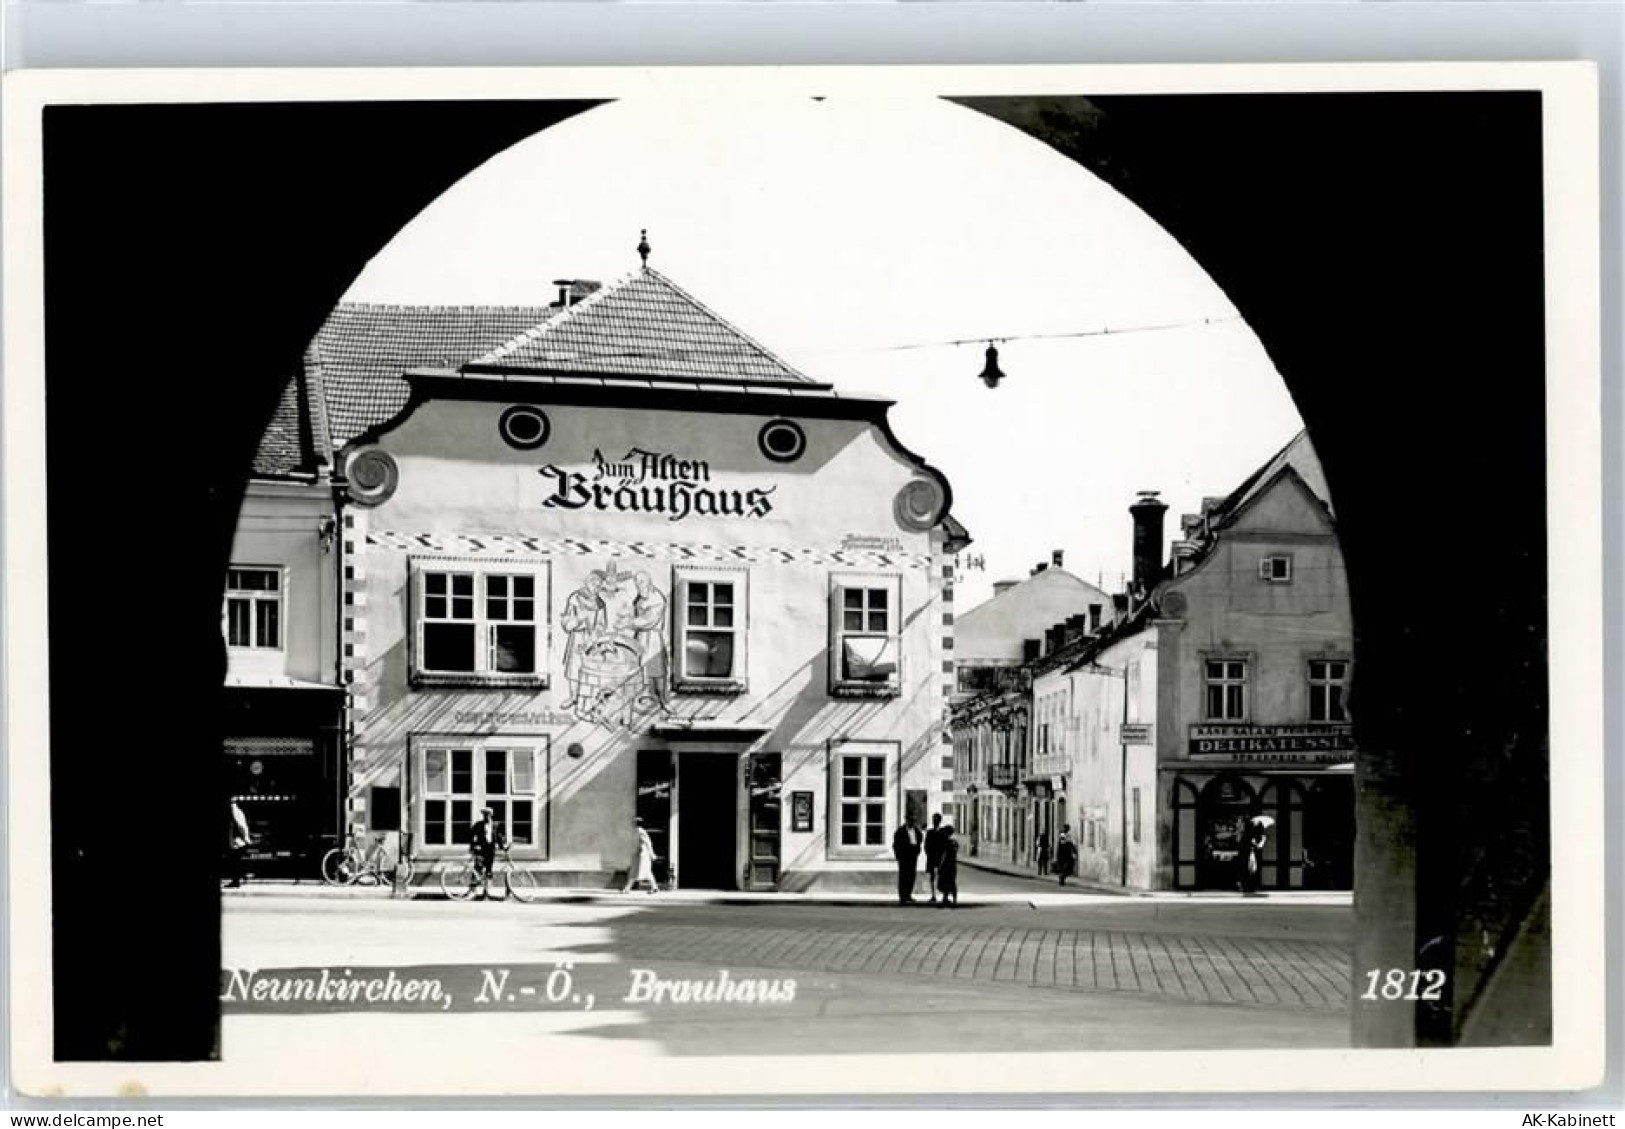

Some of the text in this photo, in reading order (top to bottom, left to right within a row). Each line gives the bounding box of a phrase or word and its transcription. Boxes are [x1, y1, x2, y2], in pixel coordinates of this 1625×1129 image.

[592, 447, 710, 484] Zum Alten
[538, 464, 777, 521] Bräuhaus
